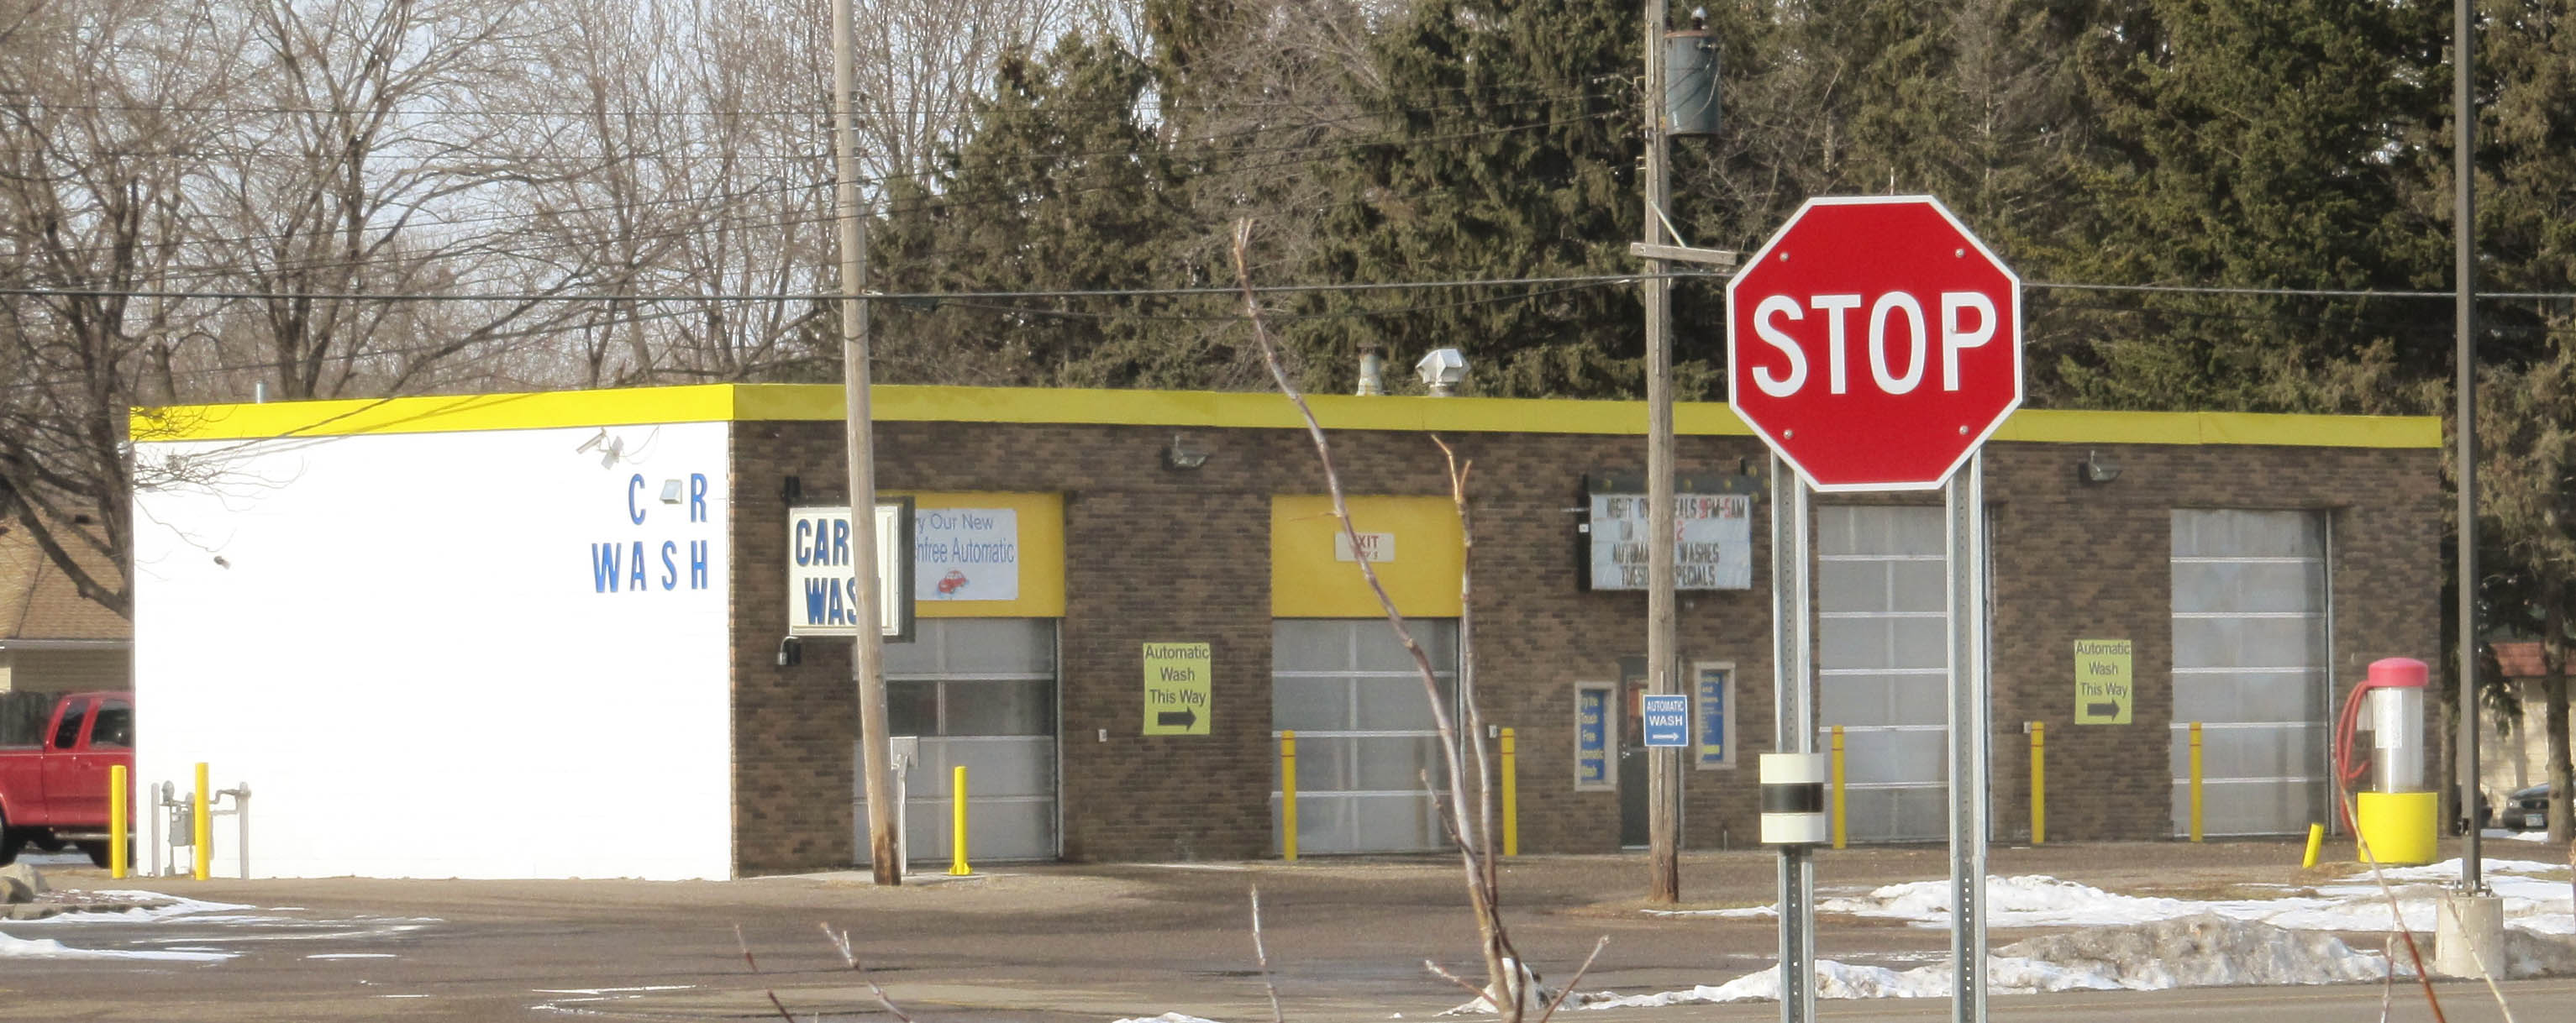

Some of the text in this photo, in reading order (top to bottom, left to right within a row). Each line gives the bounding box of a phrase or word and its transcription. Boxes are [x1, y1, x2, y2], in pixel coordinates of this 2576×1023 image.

[1752, 291, 1997, 398] STOP
[628, 473, 707, 526] CR
[1674, 498, 1697, 518] EALS
[930, 513, 958, 531] Our
[962, 514, 993, 531] New
[796, 518, 850, 567] CAR
[952, 537, 1015, 564] Automatic
[1354, 535, 1379, 548] XIT
[1679, 542, 1719, 564] WASHES
[591, 540, 708, 593] WASH
[1622, 565, 1715, 589] TUESD PECIALS
[805, 577, 858, 626] WAS
[1145, 645, 1210, 659] Automatic
[2076, 641, 2131, 655] Automatic
[1159, 667, 1196, 681] Wash
[2089, 662, 2118, 675] Wash
[1149, 690, 1207, 707] This Way
[2080, 682, 2128, 699] This Way
[1647, 700, 1685, 712] AUTOMATIC
[1648, 716, 1683, 727] WASH
